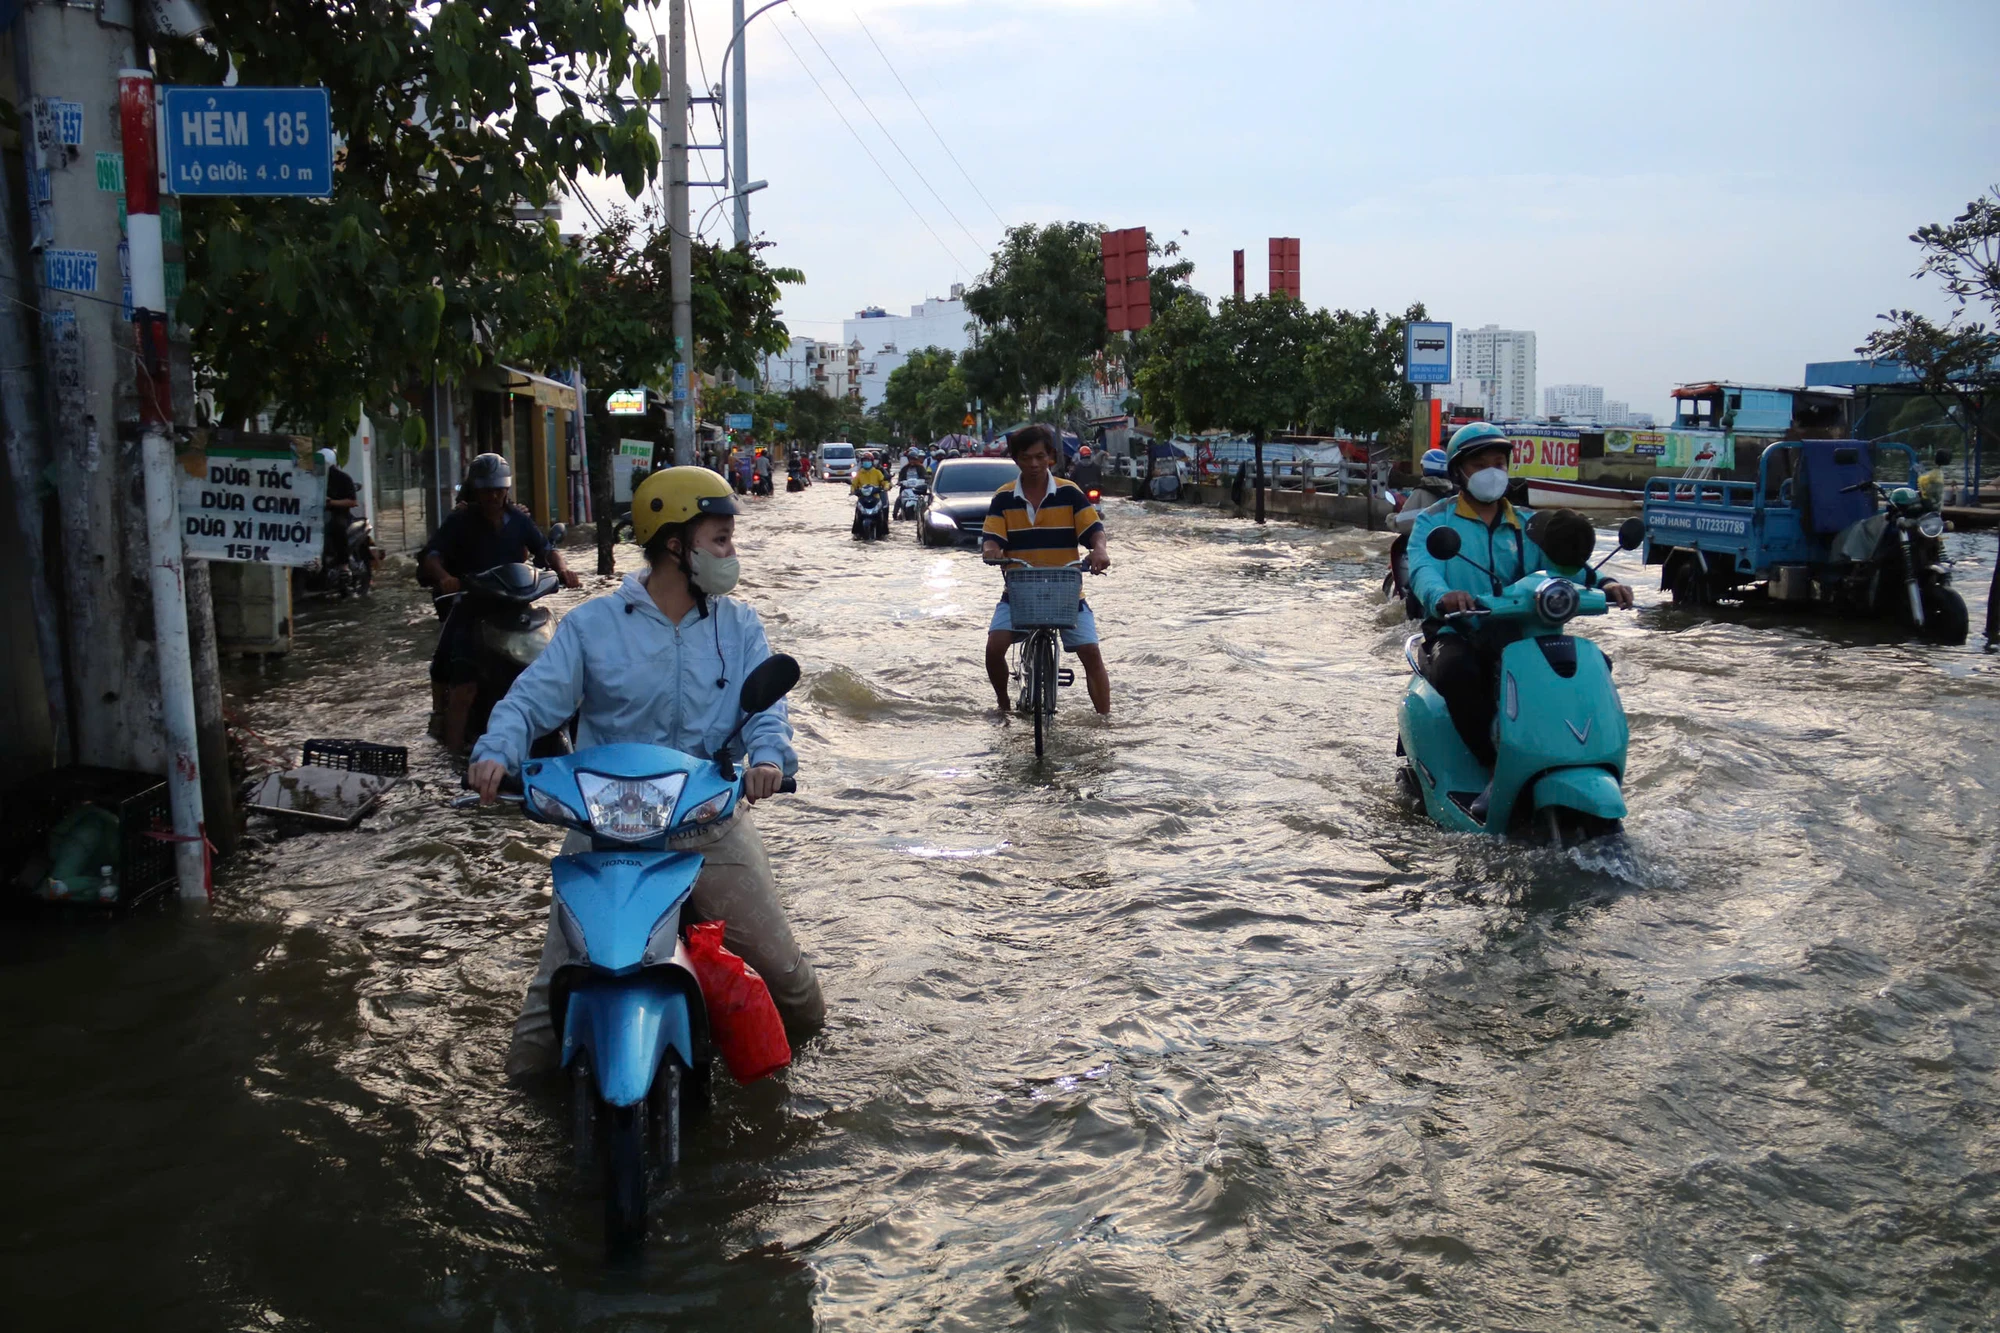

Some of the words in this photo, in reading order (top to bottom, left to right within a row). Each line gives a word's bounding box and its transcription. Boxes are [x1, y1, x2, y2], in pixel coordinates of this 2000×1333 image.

[181, 97, 249, 146] HẺM
[263, 111, 310, 146] 185
[181, 163, 201, 186] LỘ
[297, 168, 313, 180] m
[1510, 439, 1535, 470] CÁ
[1541, 440, 1579, 472] BÚN
[210, 463, 250, 486] DỪA
[256, 463, 293, 489] TẮC
[201, 489, 245, 511] DỪA
[252, 495, 300, 516] CAM
[186, 514, 226, 537] DỪA
[232, 518, 253, 541] XÍ
[259, 521, 312, 549] MUỘI
[1649, 514, 1667, 525] CHỞ
[1696, 518, 1745, 534] 0772337789
[223, 543, 271, 561] 15K
[601, 858, 643, 868] HONDA
